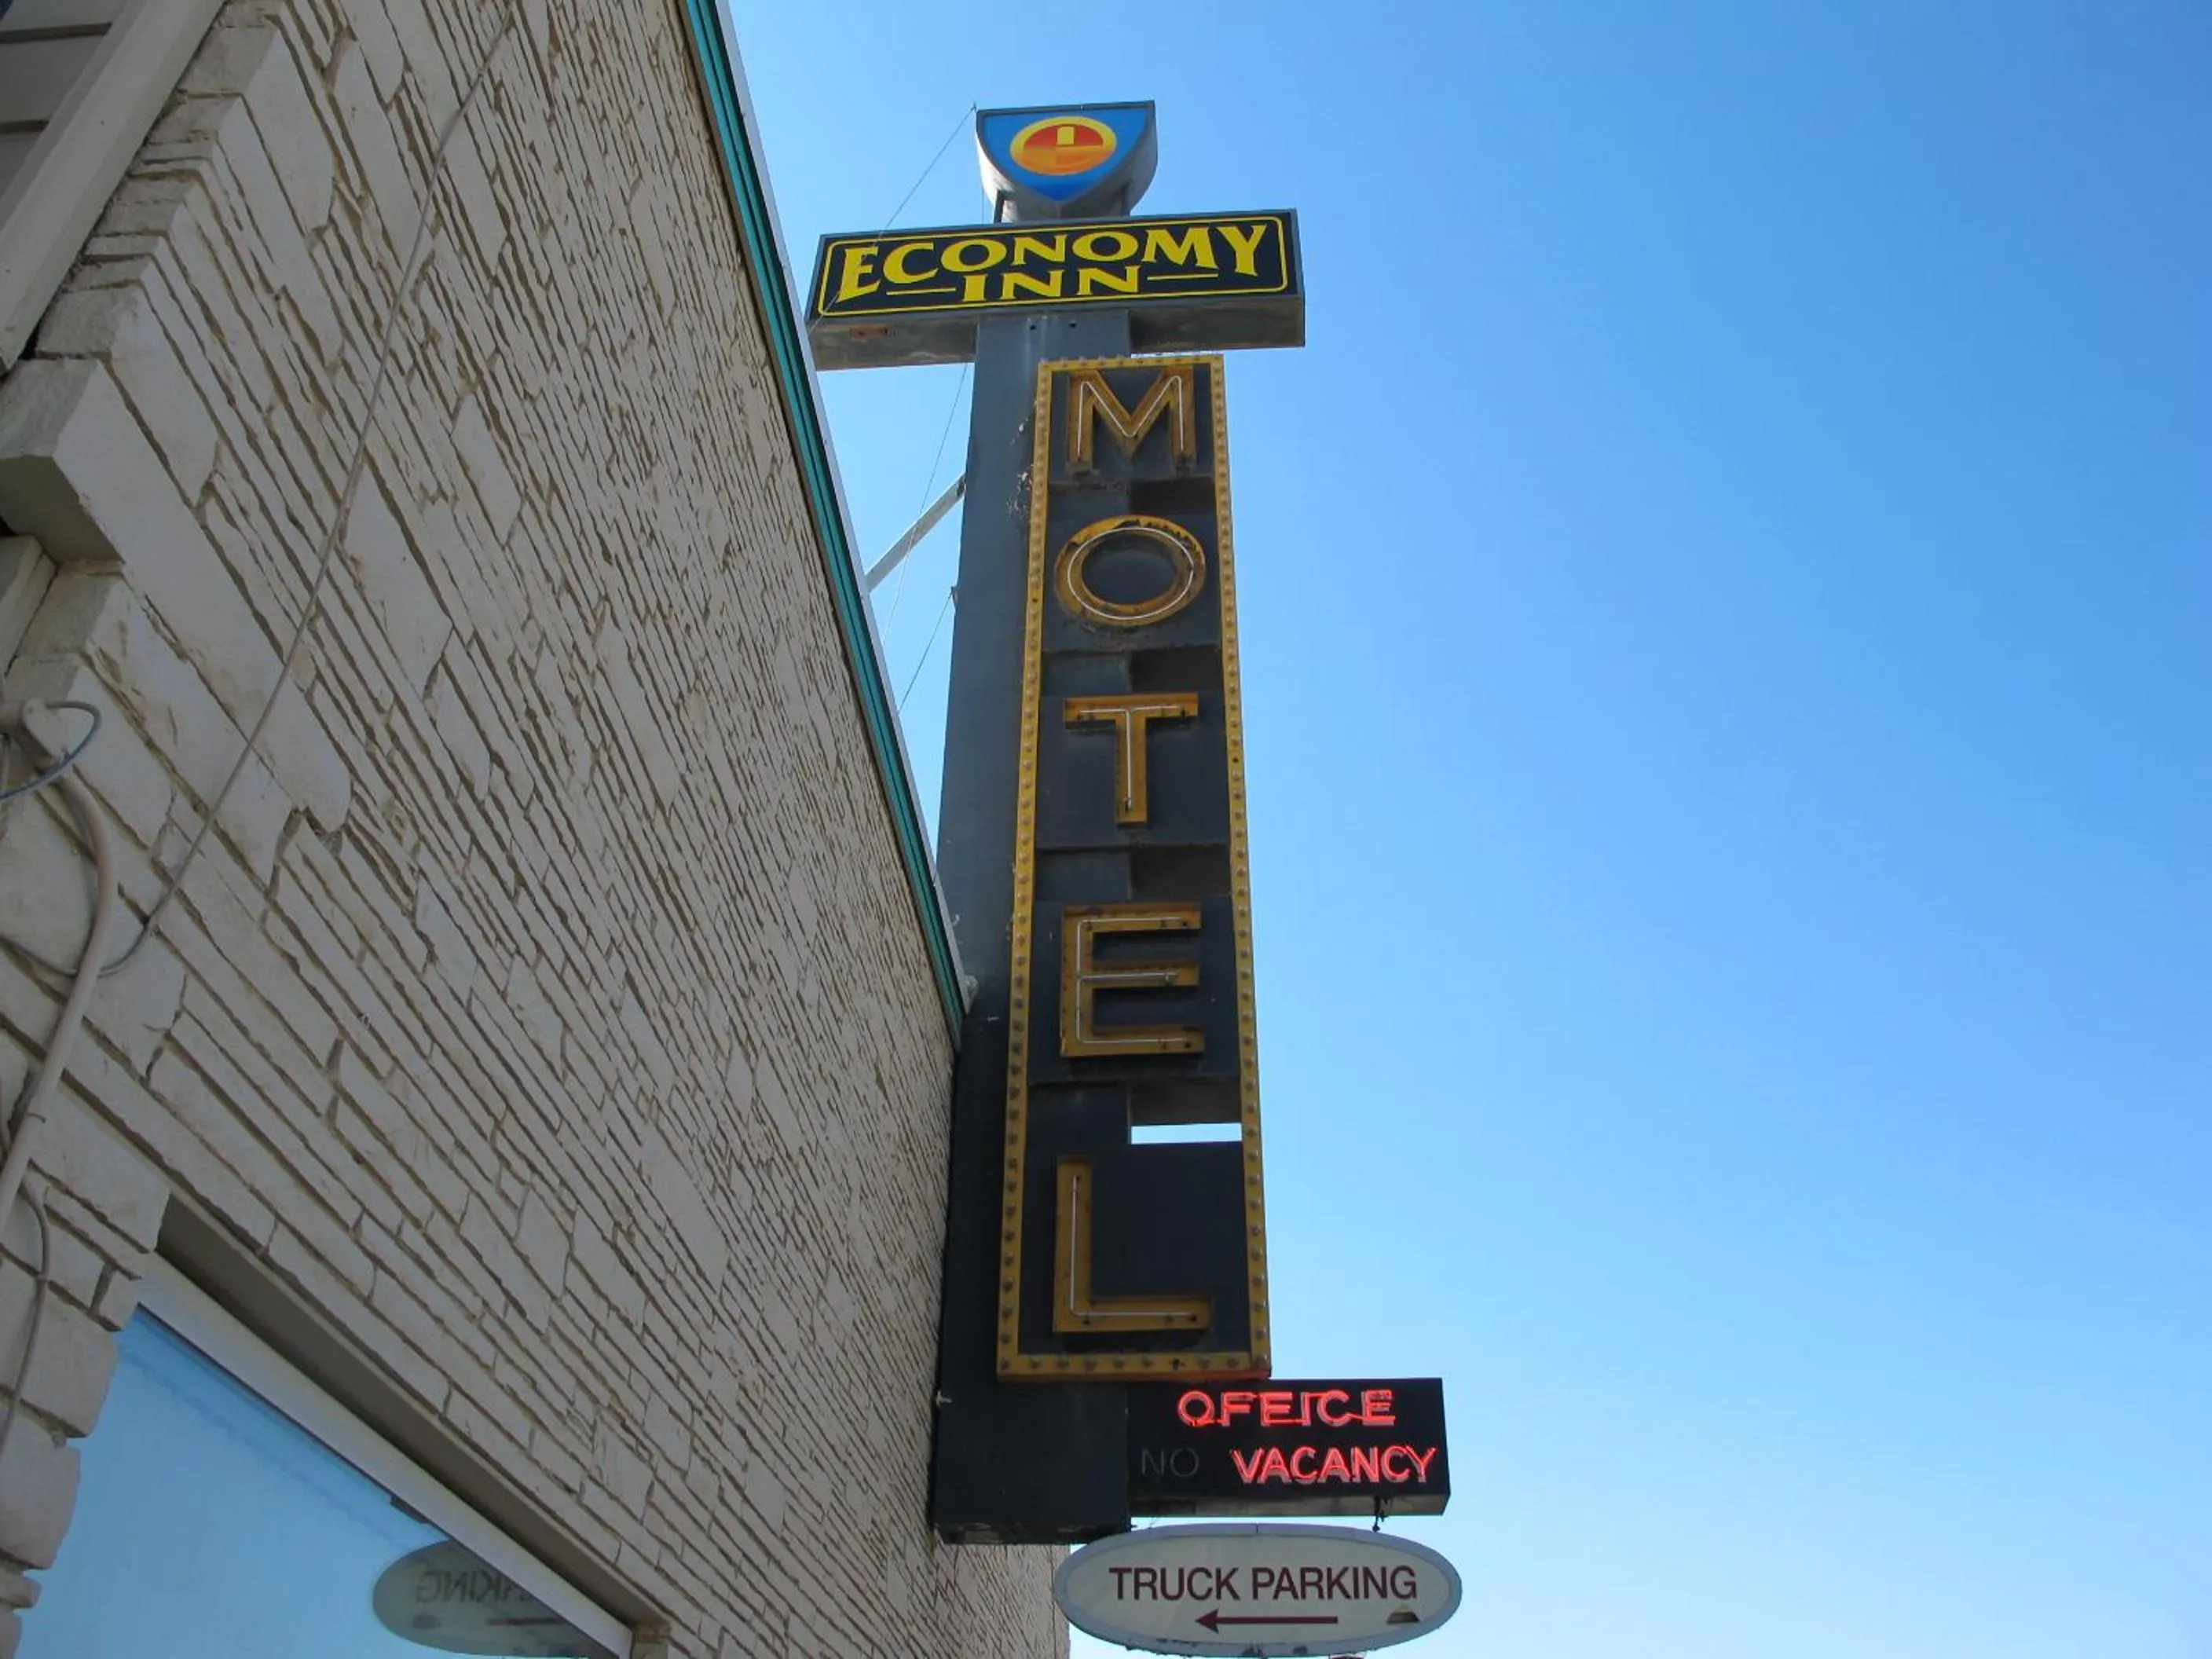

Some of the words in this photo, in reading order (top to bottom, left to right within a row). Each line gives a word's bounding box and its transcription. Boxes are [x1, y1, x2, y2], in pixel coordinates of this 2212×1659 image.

[836, 224, 1268, 304] ECONOMY
[962, 265, 1141, 302] INN
[1052, 366, 1213, 1332] MOTEL
[1141, 1447, 1200, 1479] NO
[1230, 1445, 1437, 1484] VACANCY
[1108, 1567, 1241, 1601] TRUCK
[1252, 1566, 1417, 1600] PARKING
